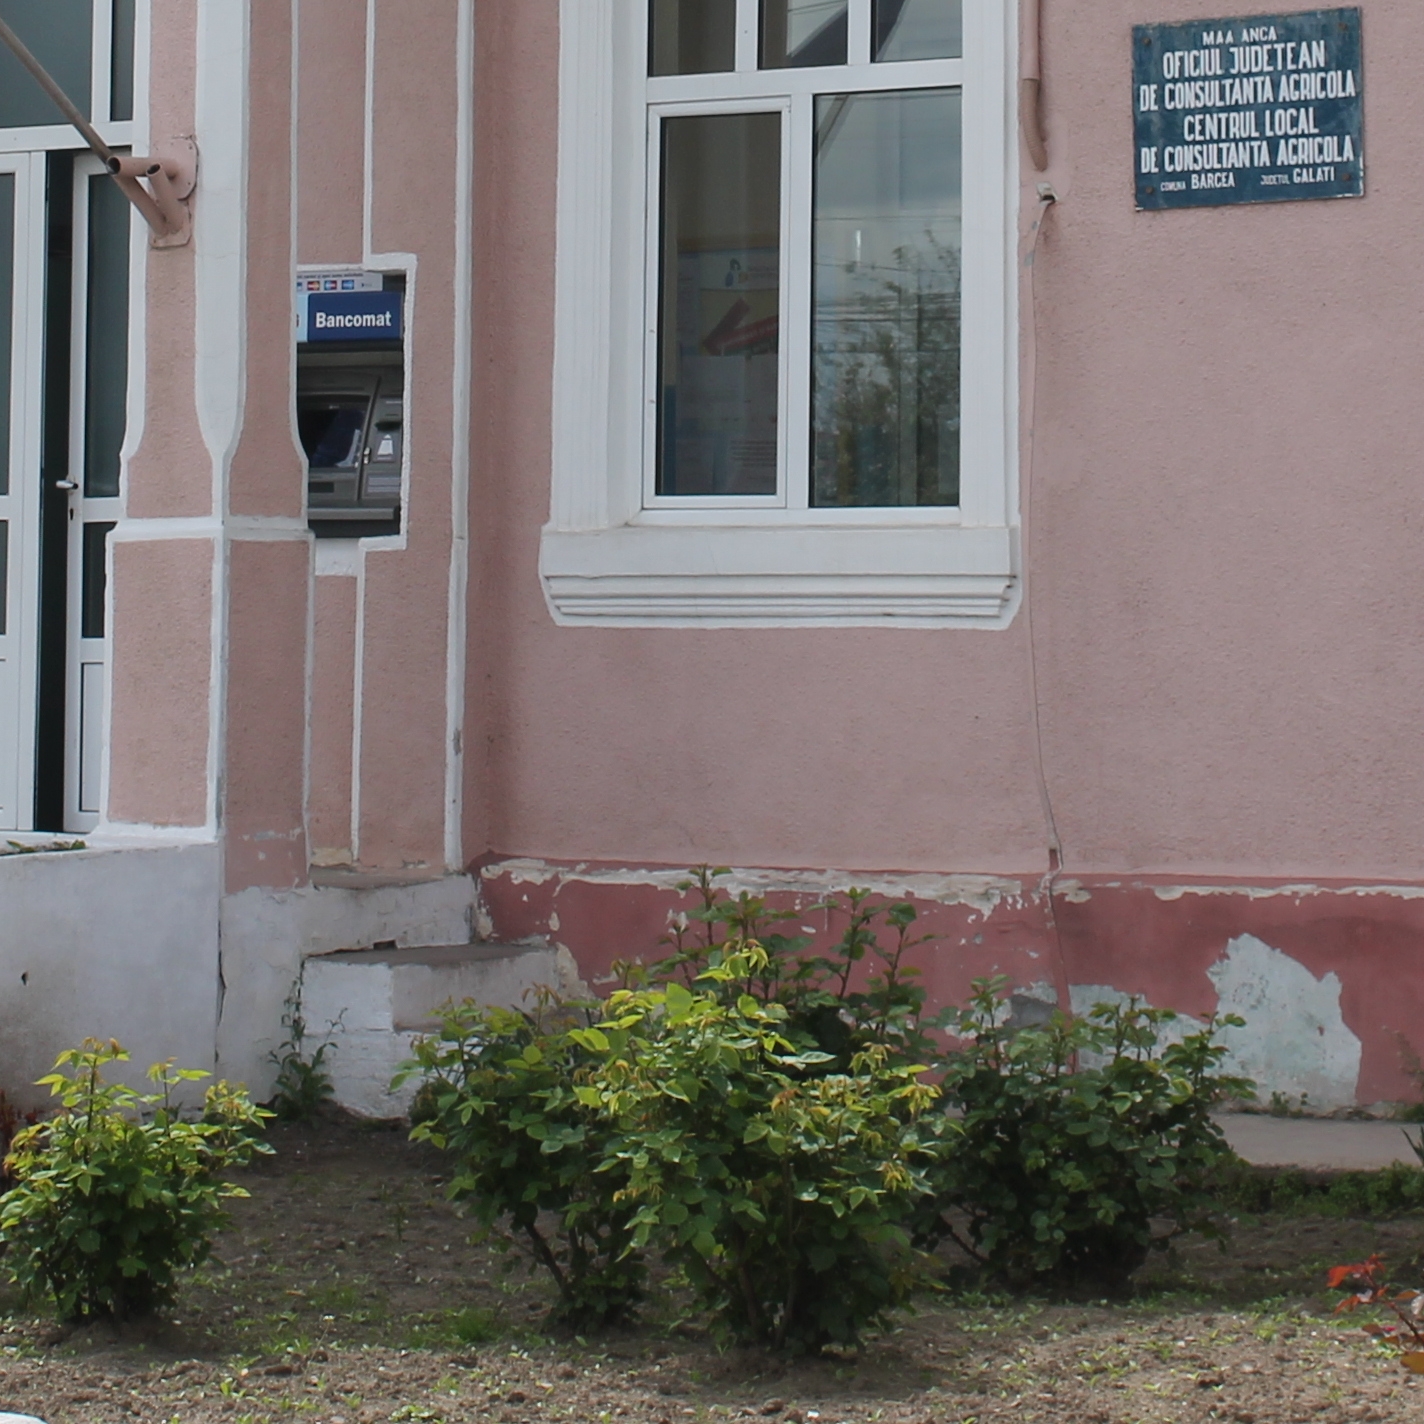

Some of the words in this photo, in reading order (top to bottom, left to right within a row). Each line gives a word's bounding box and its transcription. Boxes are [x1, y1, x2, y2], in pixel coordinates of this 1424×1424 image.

[1202, 30, 1234, 46] MAA
[1241, 26, 1278, 42] ANCA
[1163, 48, 1224, 79] OFICIUL
[1229, 40, 1325, 74] JUDETEAN
[1139, 84, 1159, 112] DE
[1164, 74, 1274, 110] CONSULTANTA
[1278, 69, 1356, 102] AGRICOLA
[1183, 111, 1260, 141] CENTRUL
[1265, 107, 1319, 136] LOCAL
[1140, 146, 1159, 174] DE
[1164, 140, 1271, 173] CONSULTANTA
[1276, 135, 1354, 166] AGRICOLA
[1191, 172, 1235, 190] BARCEA
[1293, 166, 1335, 184] GALATI
[315, 311, 392, 328] Bancomat
